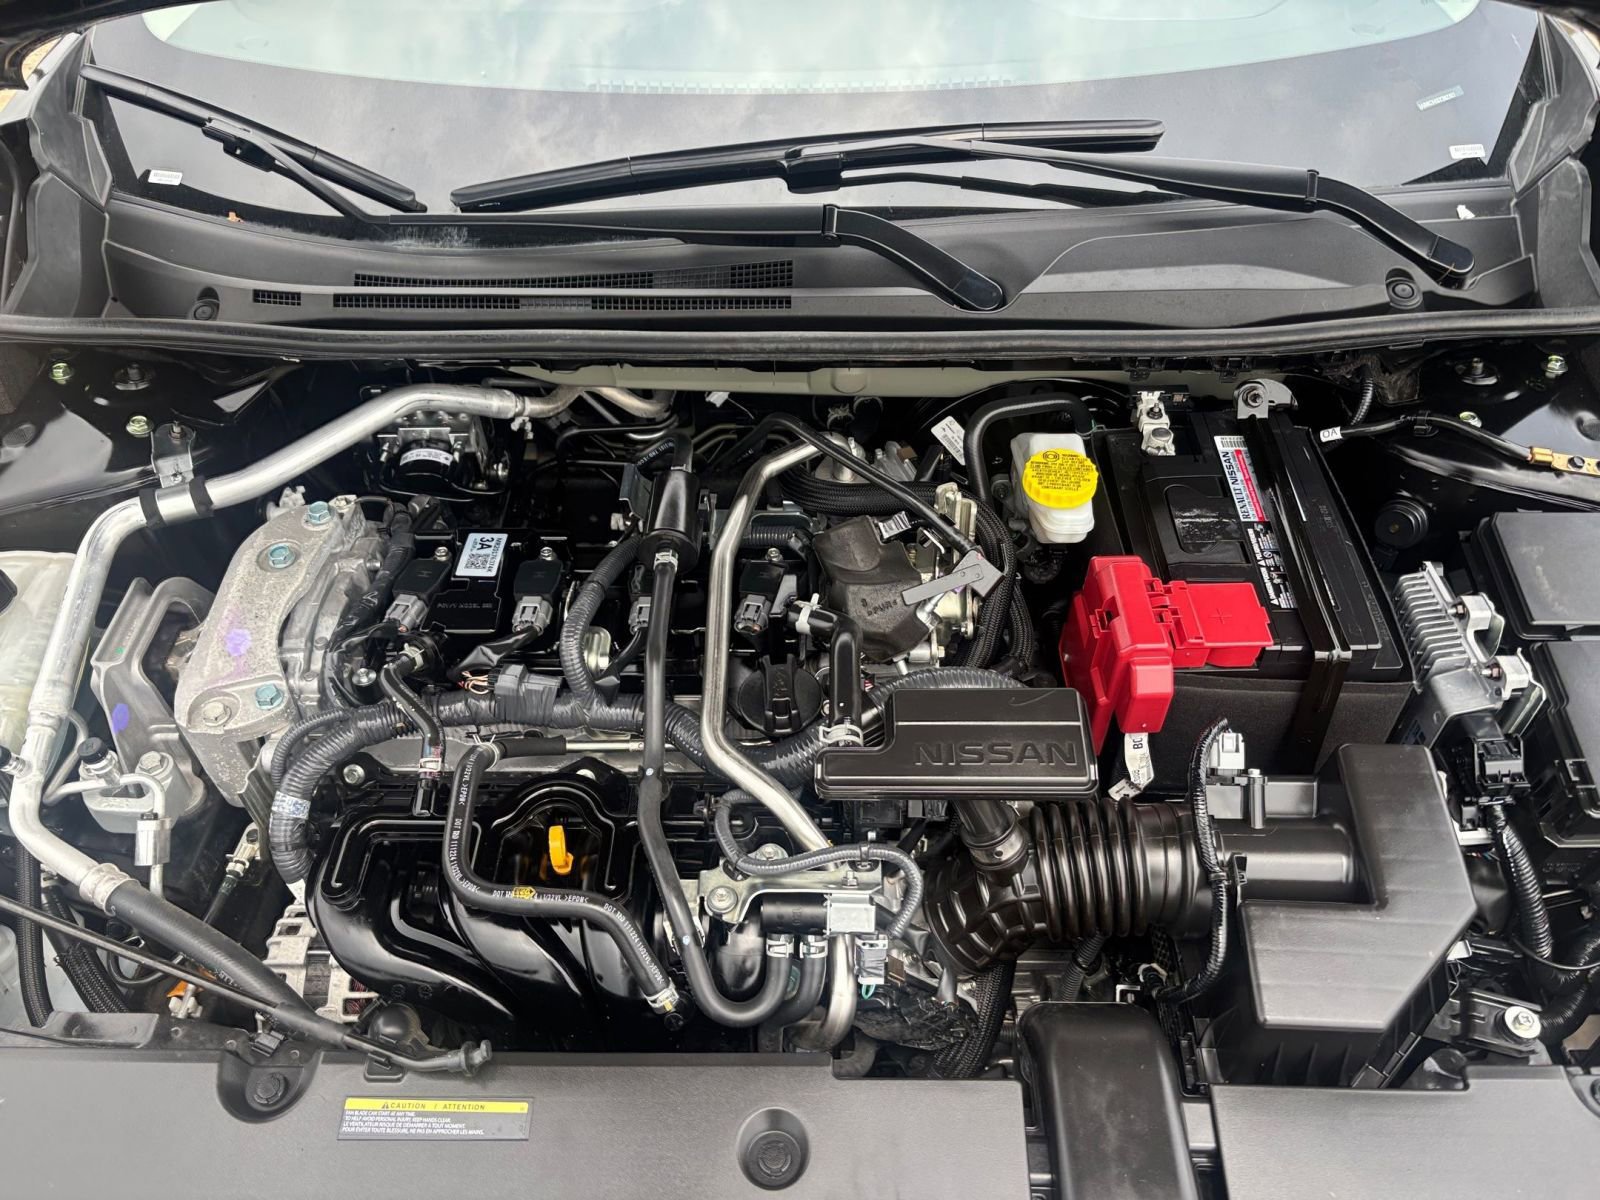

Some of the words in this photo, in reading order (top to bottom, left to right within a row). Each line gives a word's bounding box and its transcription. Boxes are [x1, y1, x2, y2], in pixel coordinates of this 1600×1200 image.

[1221, 452, 1240, 485] NISSAN
[1233, 487, 1252, 519] RENAULT
[477, 537, 495, 550] 3A
[914, 742, 1078, 766] NISSAN
[390, 1102, 426, 1110] CAUTION
[442, 1103, 486, 1111] ATTENTION
